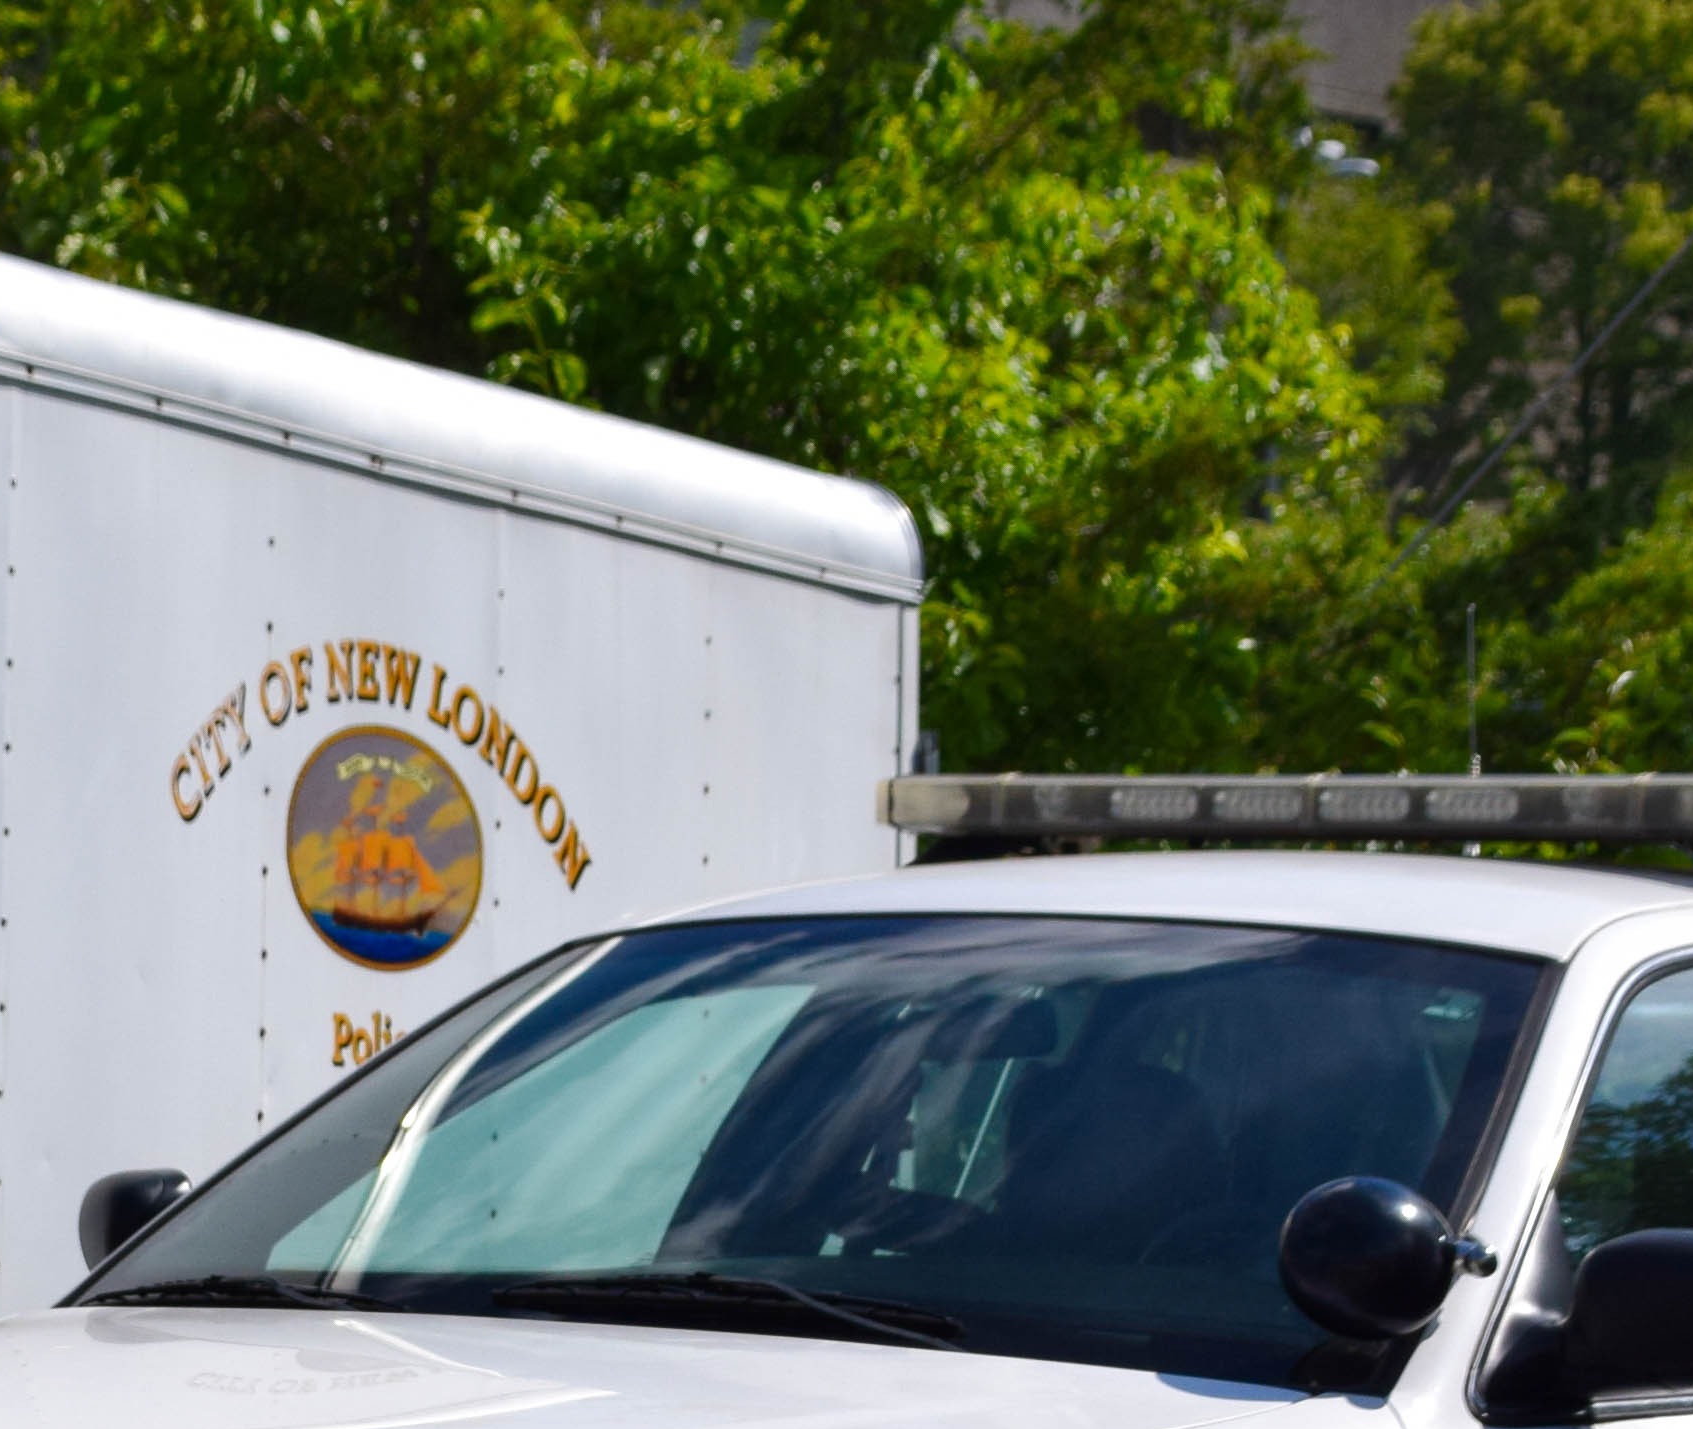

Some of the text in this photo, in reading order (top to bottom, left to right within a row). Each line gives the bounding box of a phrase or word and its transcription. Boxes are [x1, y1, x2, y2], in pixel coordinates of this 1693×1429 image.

[171, 639, 592, 891] CITY OF NEW LONDON
[332, 1011, 405, 1066] Poli
